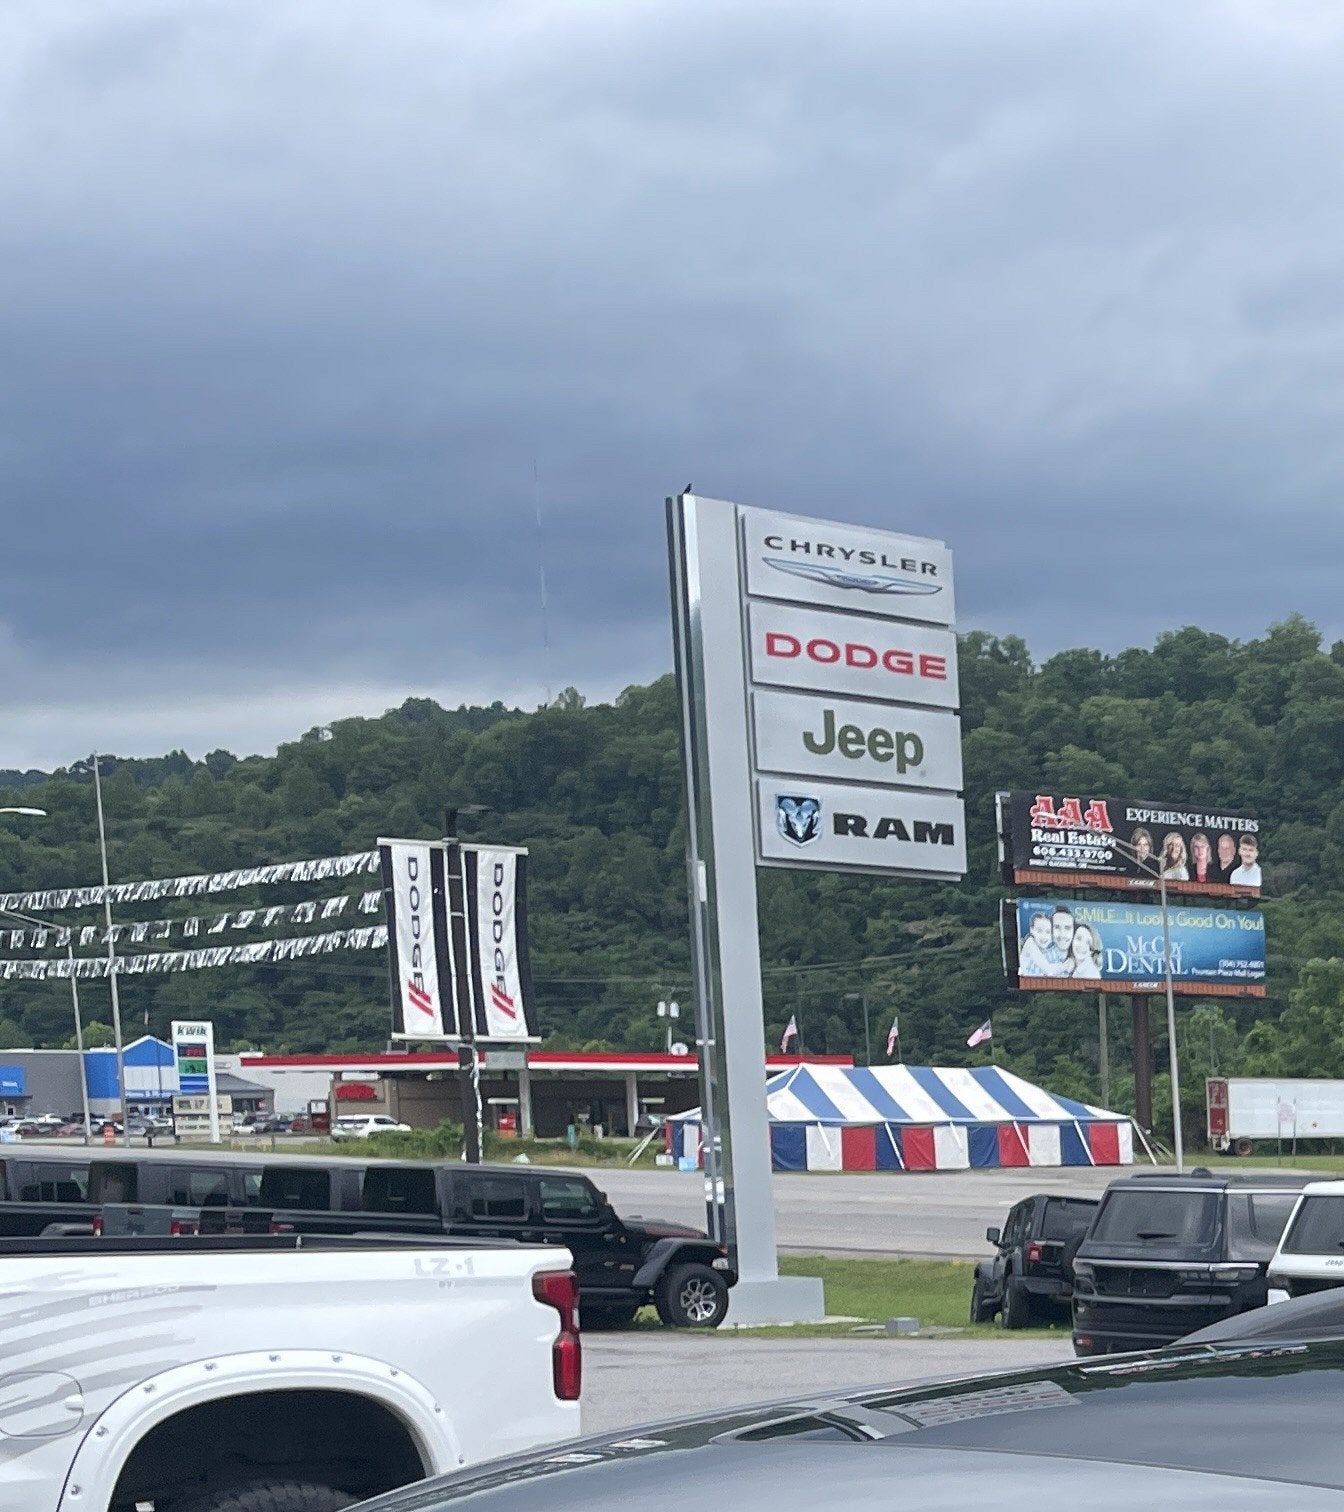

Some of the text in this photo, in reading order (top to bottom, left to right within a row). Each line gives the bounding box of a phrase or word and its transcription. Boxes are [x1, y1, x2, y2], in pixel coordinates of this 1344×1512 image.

[763, 535, 939, 577] CHRYSLER
[765, 631, 948, 680] DODGE
[802, 709, 925, 774] Jeep
[832, 812, 955, 846] RAM
[1030, 795, 1114, 832] AAA
[1125, 807, 1259, 833] EXPERIENCE MATTERS
[1031, 828, 1065, 843] Real
[407, 857, 426, 995] DODGE
[492, 863, 507, 997] DODGE
[1176, 911, 1213, 929] Good
[1215, 913, 1236, 929] On
